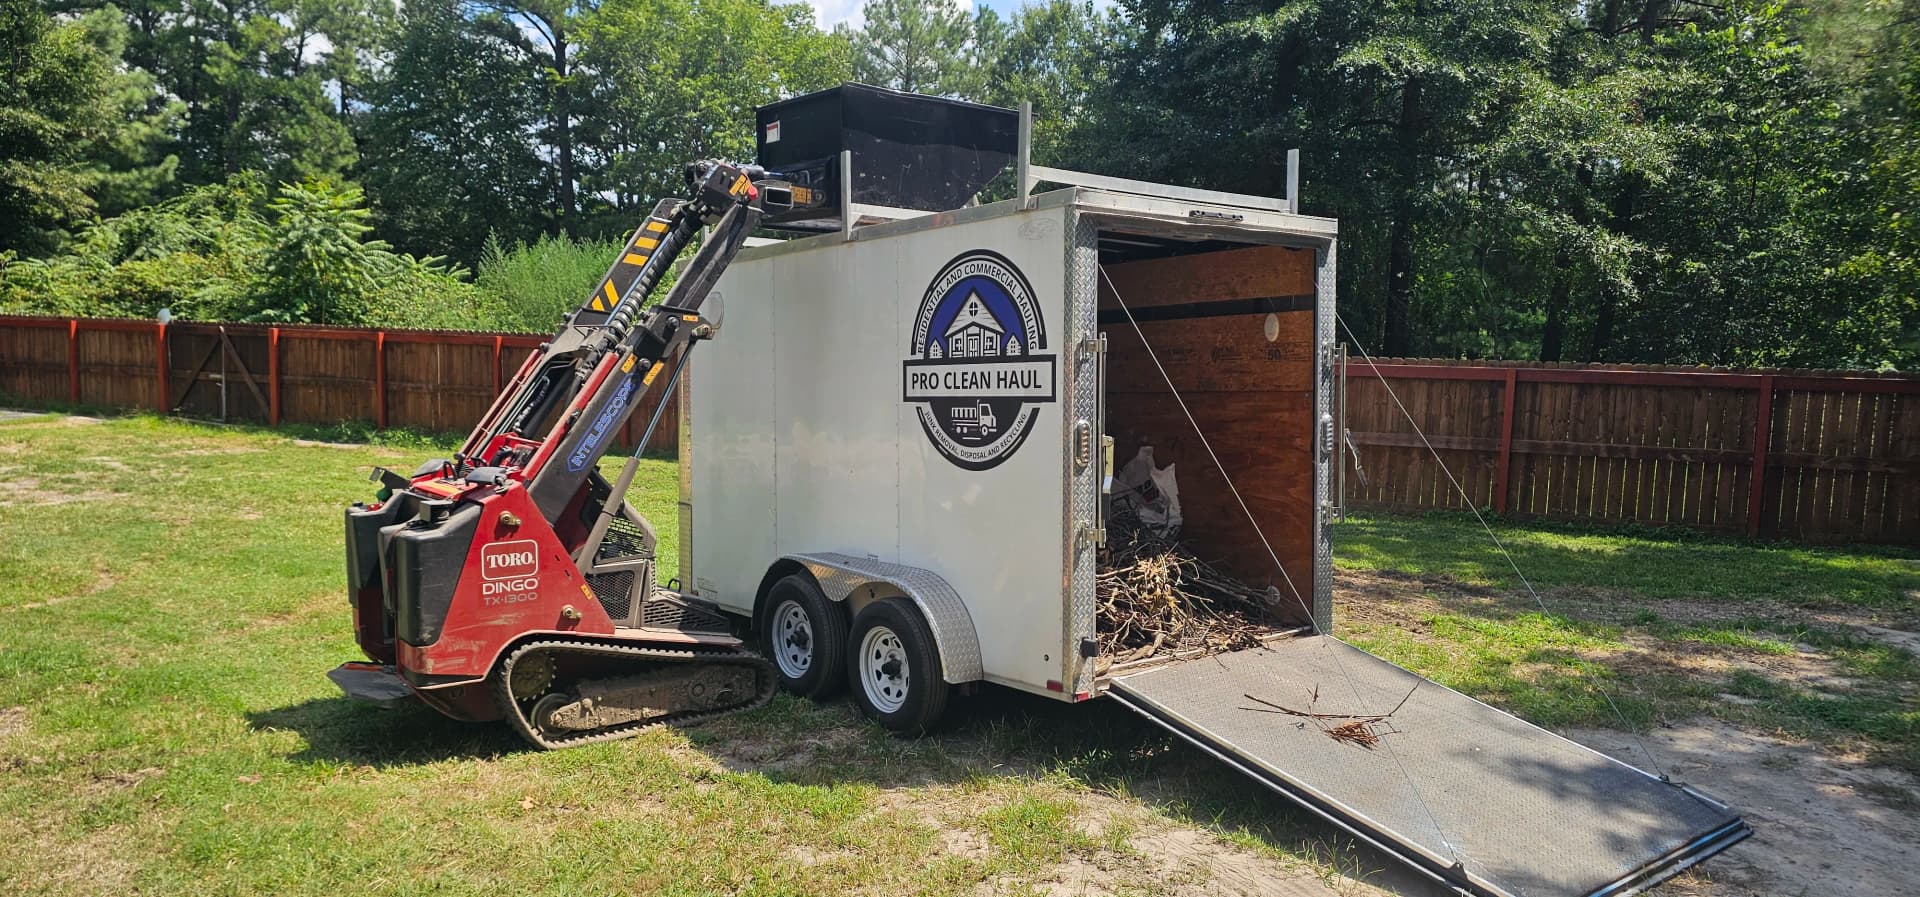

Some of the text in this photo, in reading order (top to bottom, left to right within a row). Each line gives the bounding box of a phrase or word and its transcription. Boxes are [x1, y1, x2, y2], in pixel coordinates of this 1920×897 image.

[917, 263, 1038, 353] RESIDENTIAL AND COMMERCIAL HAULING
[911, 369, 1042, 390] PRO CLEAN HAUL
[924, 411, 937, 431] JUNK
[960, 449, 987, 459] DISPOSAL
[988, 446, 1000, 457] AND
[999, 414, 1027, 449] RECYCLING
[482, 578, 538, 595] DINGO
